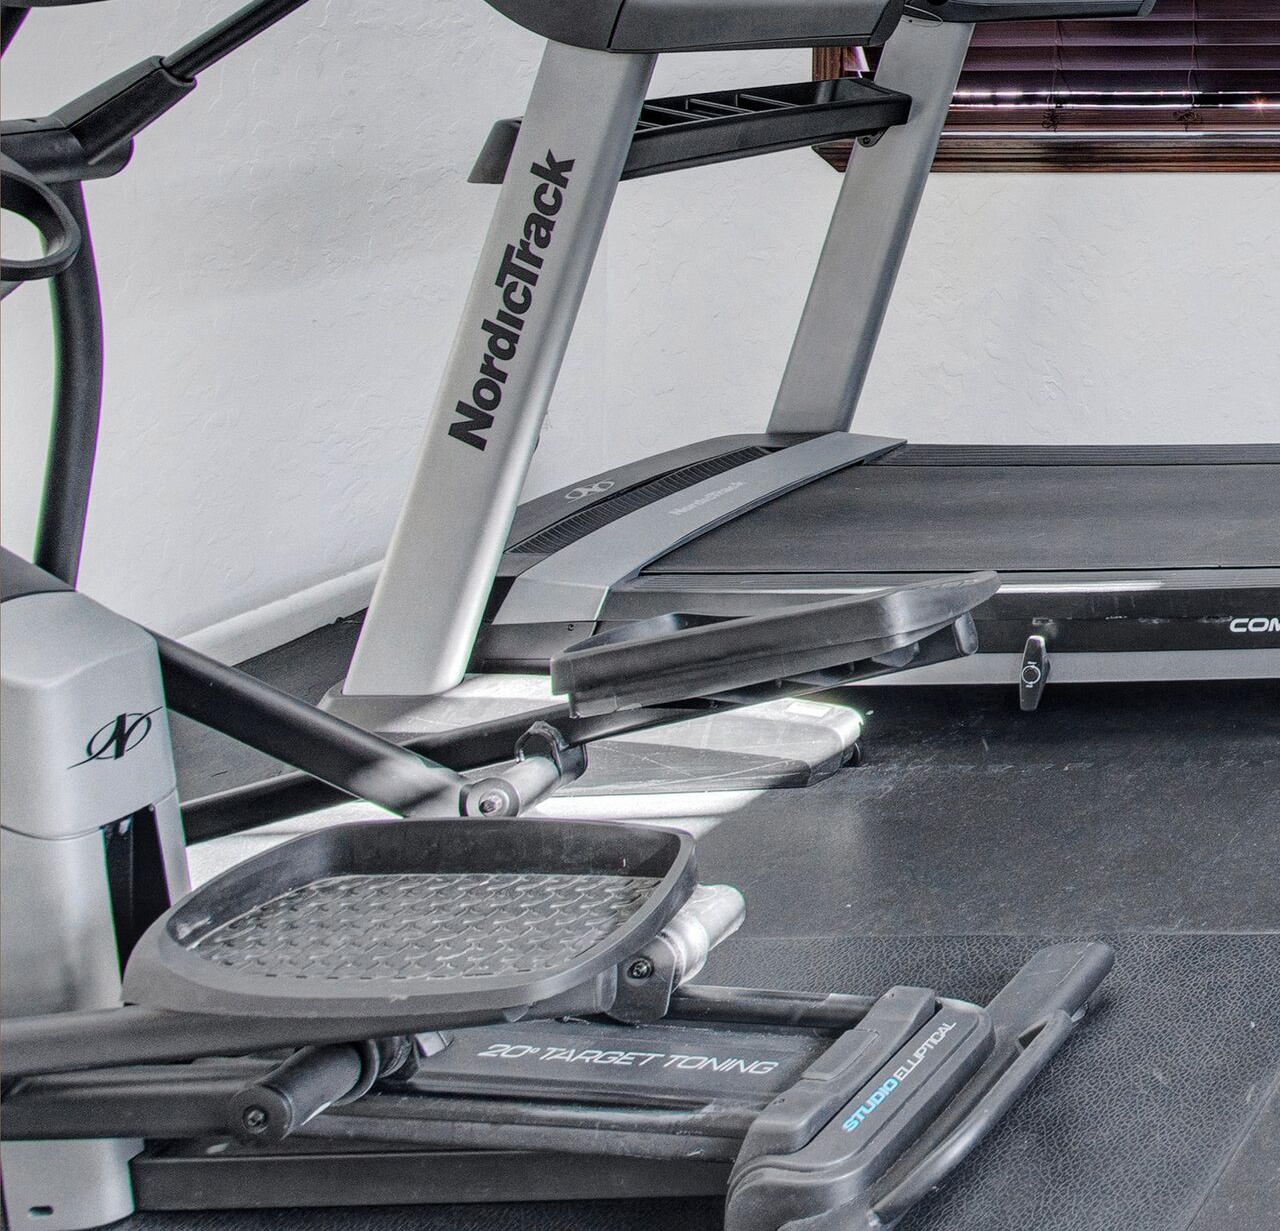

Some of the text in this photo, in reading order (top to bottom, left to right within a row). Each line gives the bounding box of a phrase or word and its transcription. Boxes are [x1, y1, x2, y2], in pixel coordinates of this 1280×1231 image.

[447, 148, 575, 451] NordicTrack
[539, 1047, 666, 1066] TARGET
[662, 1054, 779, 1074] TONING
[842, 1022, 957, 1132] STUDIO ELLIPTICAL
